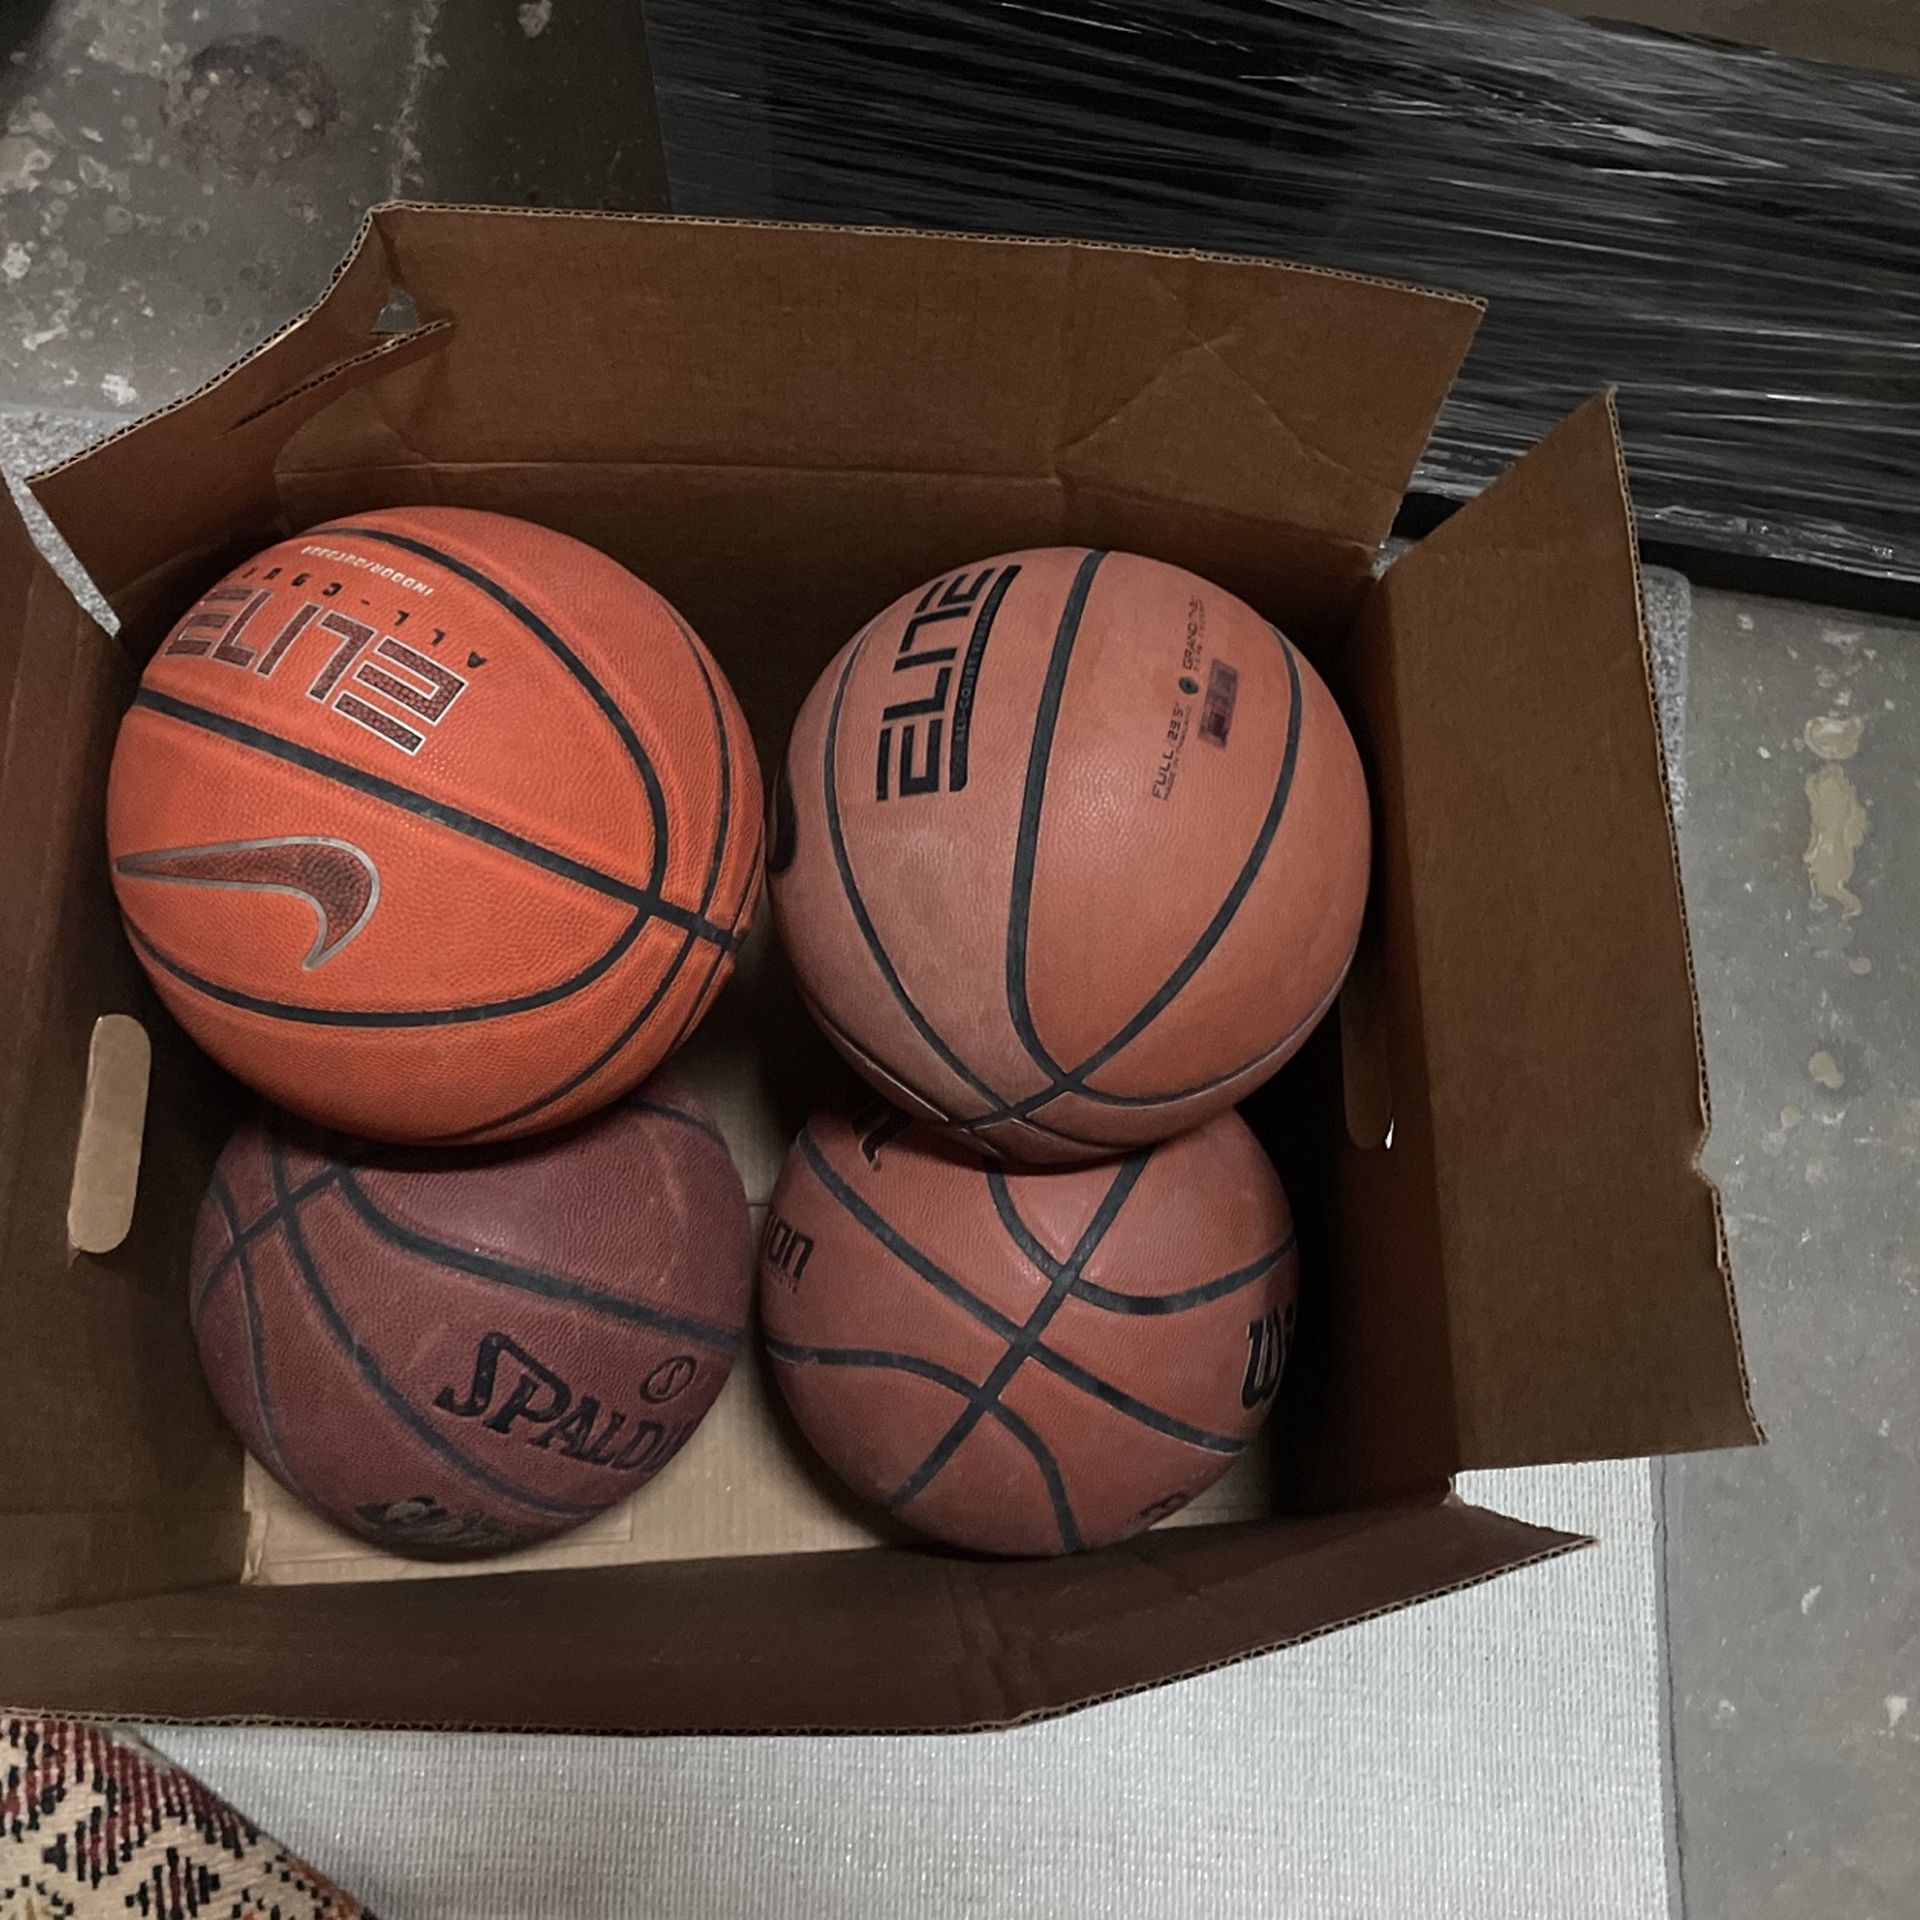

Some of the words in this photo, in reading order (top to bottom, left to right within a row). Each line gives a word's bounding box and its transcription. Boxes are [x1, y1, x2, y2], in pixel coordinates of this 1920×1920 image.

[165, 587, 469, 757] ELITE
[876, 568, 996, 802] ELITE
[1152, 749, 1174, 799] FULL
